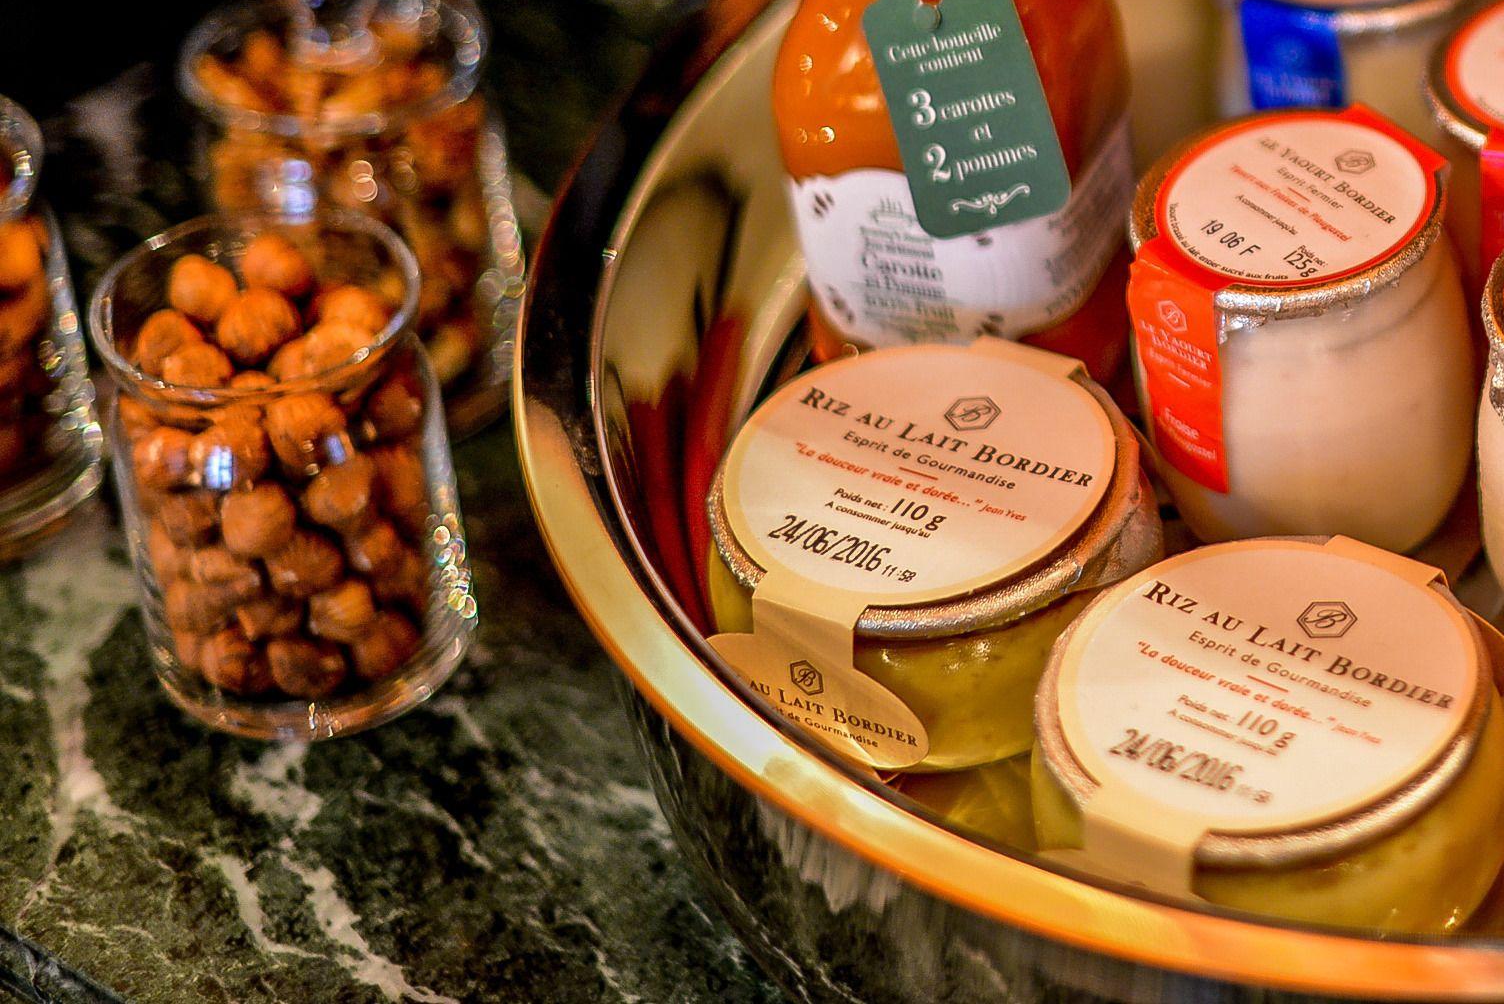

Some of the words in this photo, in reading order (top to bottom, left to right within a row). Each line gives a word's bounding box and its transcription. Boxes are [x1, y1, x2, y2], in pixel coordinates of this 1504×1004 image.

[888, 43, 930, 63] Cette
[932, 23, 1002, 52] bouteille
[919, 48, 984, 73] contient
[911, 89, 937, 126] 3
[940, 91, 1017, 120] carottes
[974, 123, 993, 141] et
[925, 145, 952, 182] 2
[955, 145, 1038, 181] pommes
[1280, 147, 1336, 183] YAOURT
[1333, 179, 1396, 225] BORDIER
[1306, 183, 1344, 213] Fermier
[1201, 219, 1224, 236] 19
[1220, 231, 1245, 249] 06
[1239, 244, 1262, 256] F
[1221, 265, 1245, 276] sucré
[1265, 272, 1288, 280] fruits
[799, 386, 851, 417] RIZ
[856, 412, 893, 430] AU
[898, 422, 968, 452] LAIT
[971, 444, 1093, 487] BORDIER
[844, 430, 890, 452] Esprit
[892, 447, 911, 459] de
[916, 454, 1016, 489] Gourmandise
[818, 451, 869, 475] douceur
[871, 470, 903, 486] vraie
[906, 482, 920, 492] et
[978, 503, 1004, 516] Jean
[1006, 509, 1027, 521] Yves
[835, 487, 863, 503] Poids
[890, 498, 929, 521] 110
[924, 514, 947, 531] g
[835, 504, 891, 526] consommer
[891, 520, 931, 539] jusqu'au
[768, 514, 891, 572] 24/06/2016
[1142, 580, 1199, 614] RIZ
[1202, 611, 1244, 632] AU
[1246, 625, 1322, 662] LAIT
[1325, 655, 1455, 709] BORDIER
[1161, 654, 1216, 681] douceur
[1217, 678, 1251, 697] vraie
[1253, 692, 1269, 703] et
[1188, 630, 1237, 657] Esprit
[1240, 654, 1261, 667] de
[1266, 662, 1372, 708] Gourmandise
[750, 680, 771, 696] AU
[778, 688, 825, 715] LAIT
[832, 707, 918, 747] BORDIER
[787, 712, 801, 722] de
[804, 717, 879, 748] Gourmandise
[1237, 710, 1279, 736] 110
[1274, 731, 1297, 749] g
[1108, 728, 1245, 791] 24/06/2016
